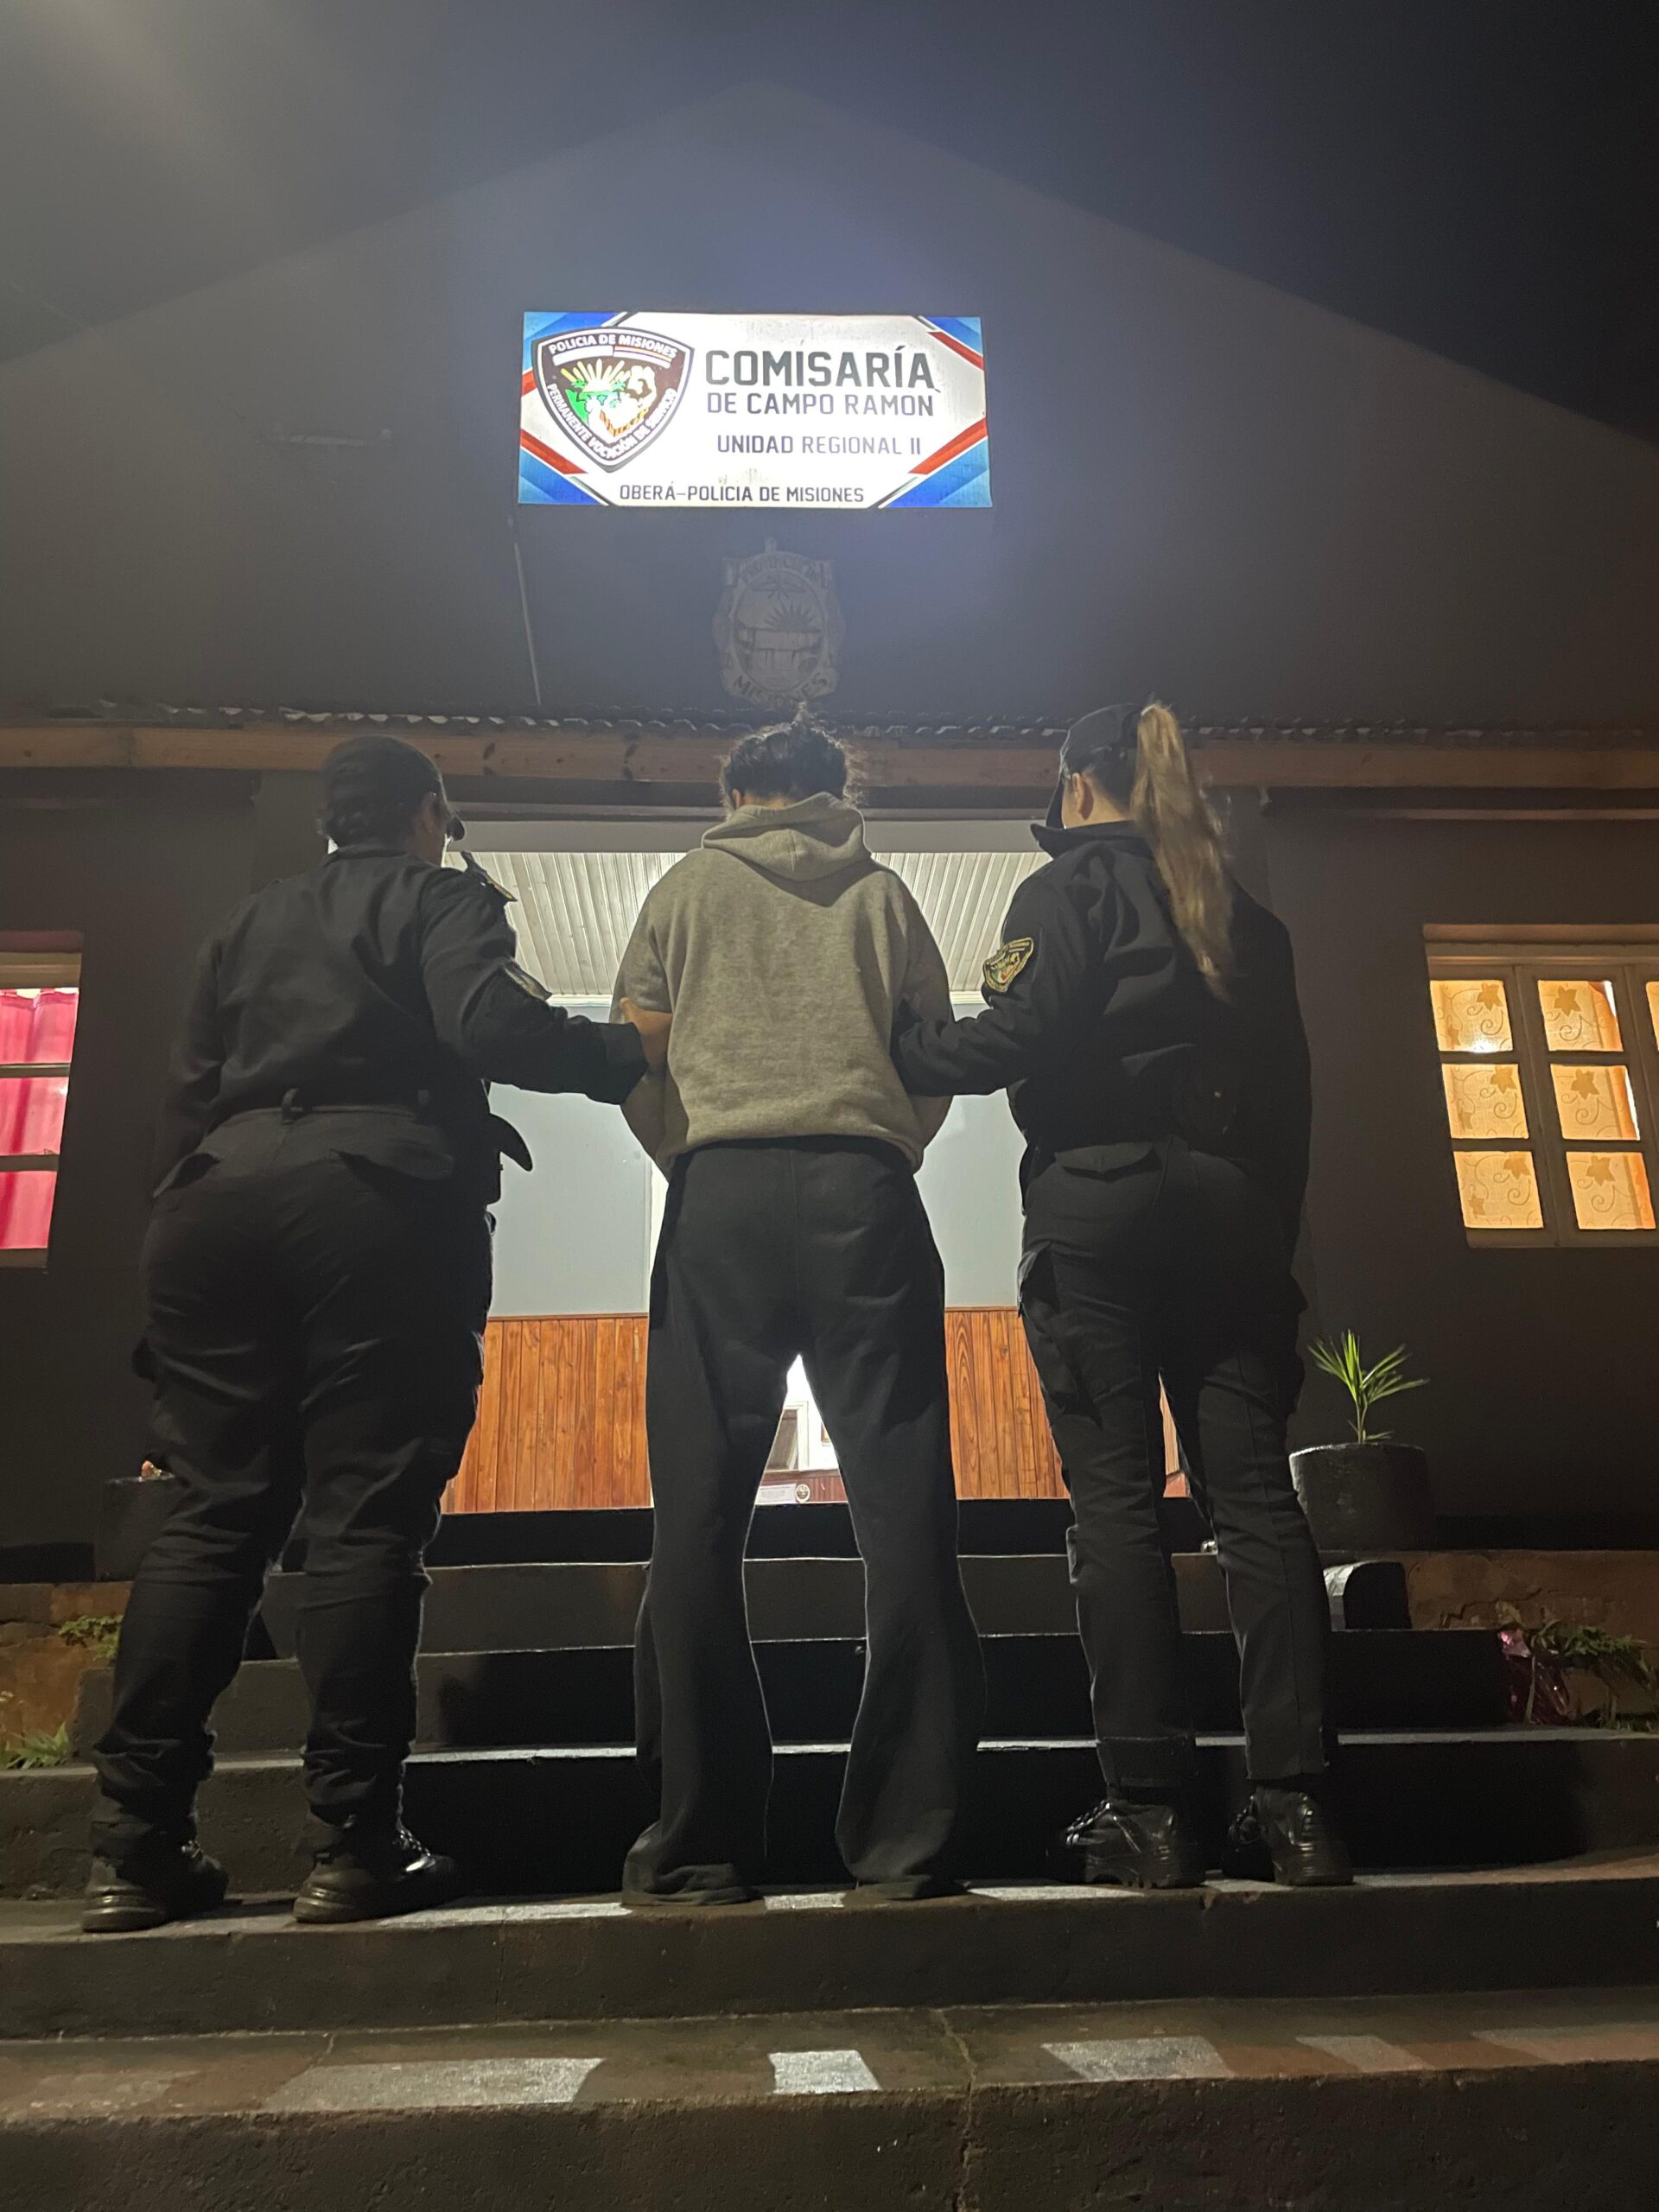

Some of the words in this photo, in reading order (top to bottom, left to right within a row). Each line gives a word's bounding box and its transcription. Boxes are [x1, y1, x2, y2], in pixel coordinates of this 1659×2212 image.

[548, 334, 596, 354] POLICIA
[599, 334, 615, 345] DE
[619, 335, 677, 359] MISIONES
[705, 346, 934, 389] COMISARÍA
[547, 384, 591, 442] PERMANENTE
[708, 392, 737, 414] DE
[747, 393, 833, 415] CAMPO
[844, 394, 934, 416] RAMON
[717, 436, 793, 454] UNIDAD
[802, 437, 902, 454] REGIONAL
[910, 438, 921, 454] II
[760, 486, 781, 502] DE
[786, 486, 864, 503] MISIONES
